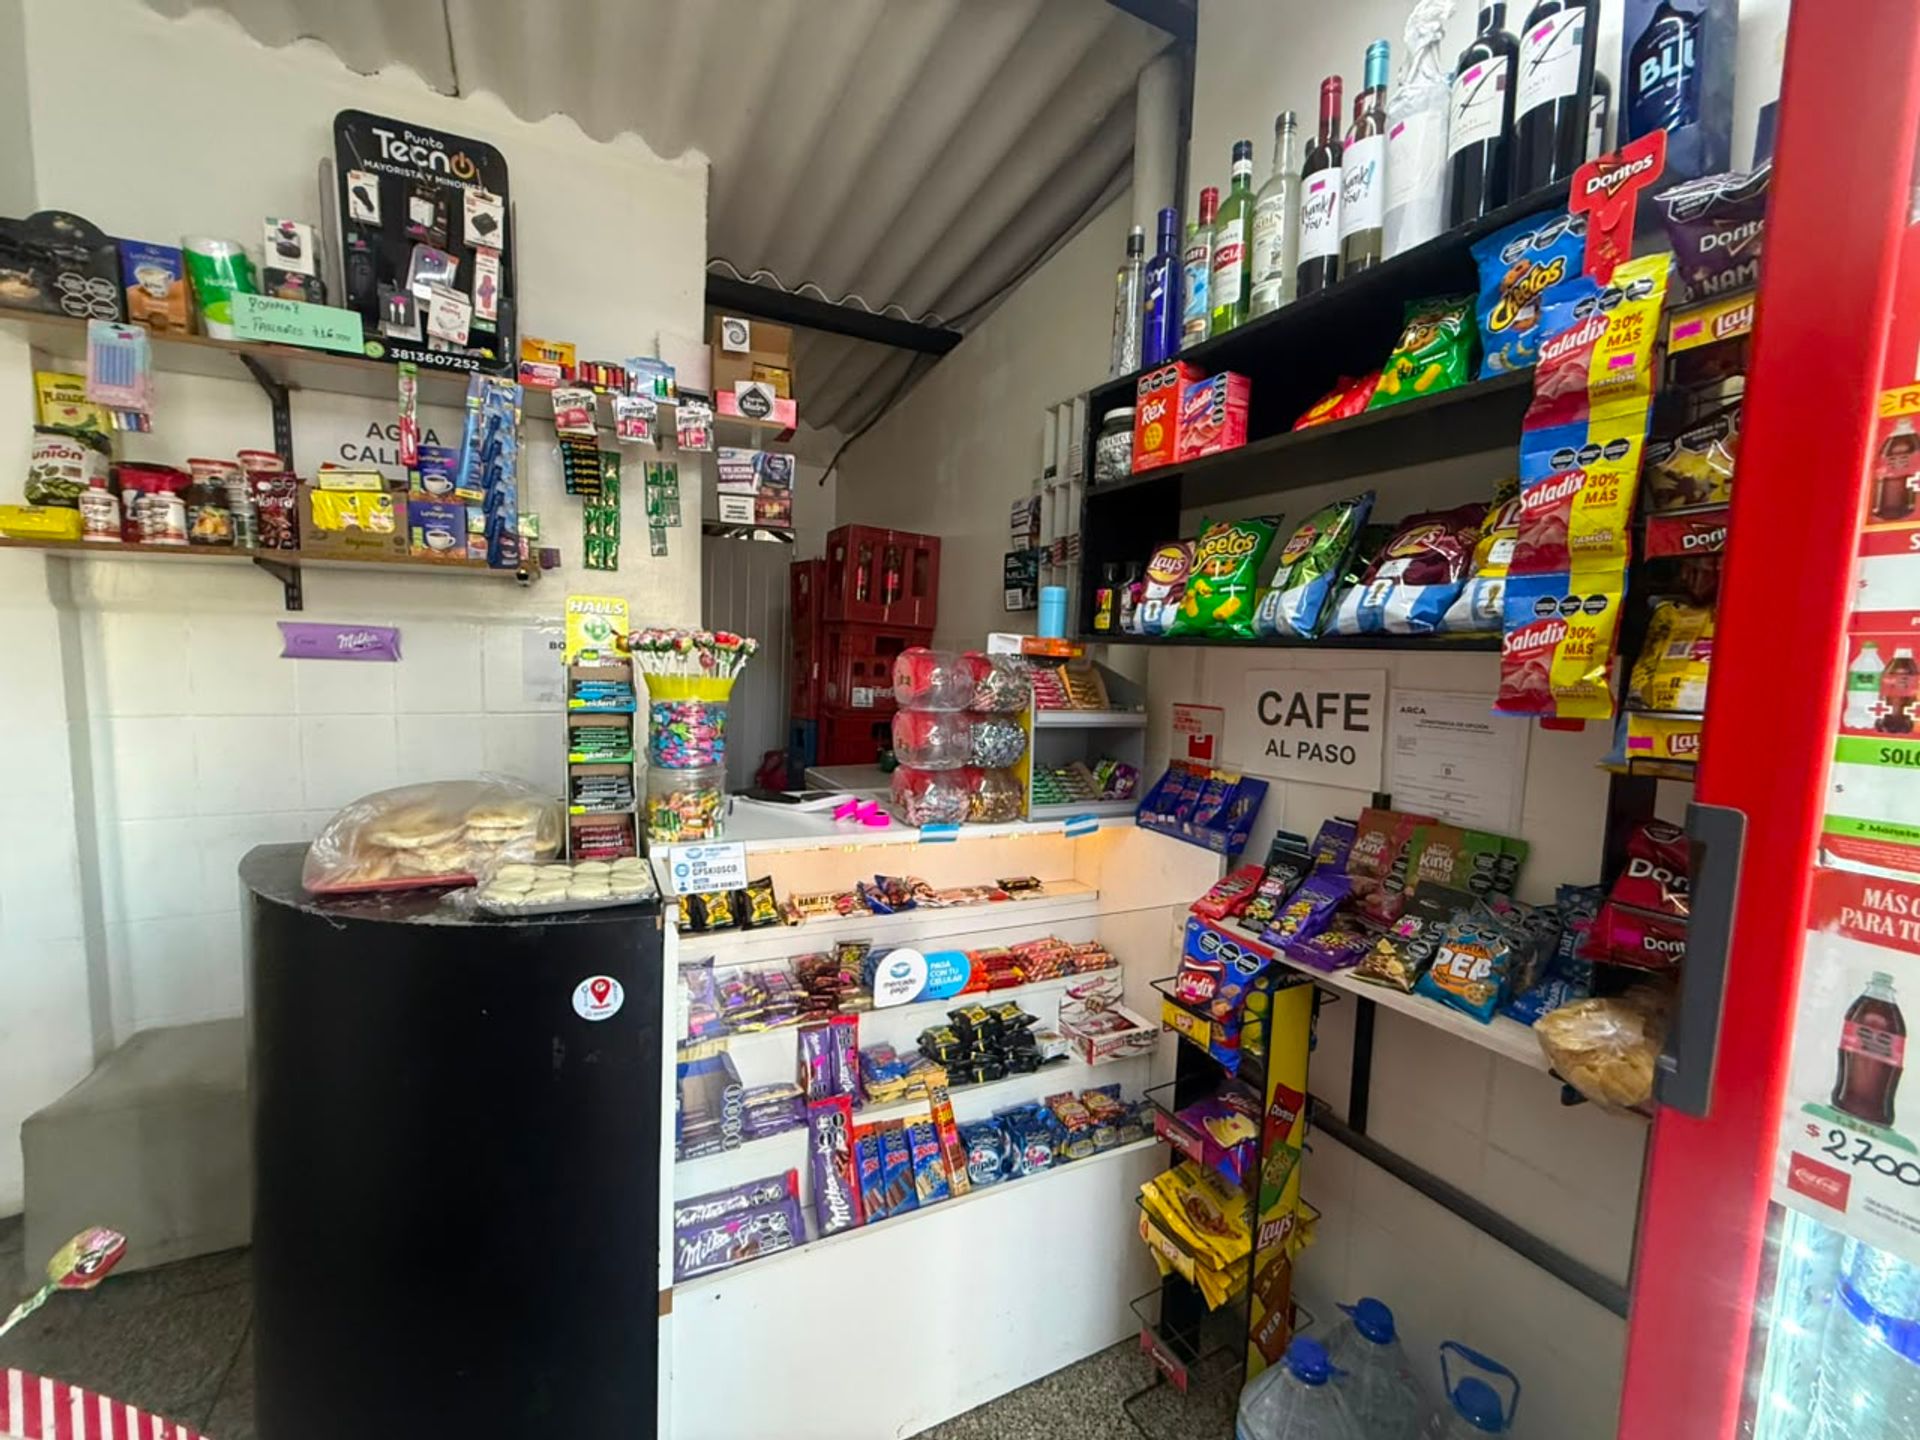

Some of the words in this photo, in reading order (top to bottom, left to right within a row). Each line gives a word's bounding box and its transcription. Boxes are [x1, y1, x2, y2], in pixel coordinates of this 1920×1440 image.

[404, 130, 444, 150] Punto
[363, 159, 423, 180] MAYORISTA
[425, 171, 433, 182] Y
[1586, 153, 1654, 194] Doritos
[1488, 256, 1567, 332] Cheetos
[1612, 311, 1645, 331] 30%
[1538, 317, 1608, 367] Saladix
[1606, 327, 1642, 348] MÁS
[390, 348, 480, 371] 3813607252
[366, 421, 441, 446] AGA
[1588, 472, 1620, 489] 30%
[1519, 472, 1586, 513] Saladix
[1584, 487, 1618, 504] MÁS
[569, 600, 626, 616] HALLS
[336, 631, 378, 650] Milka
[1502, 621, 1567, 655] Saladix
[1568, 626, 1597, 640] 30%
[1257, 690, 1372, 732] CAFE
[1400, 706, 1427, 715] ARCA
[1265, 738, 1291, 758] AL
[1297, 741, 1356, 765] PASO
[1862, 887, 1908, 915] MÁS
[1840, 906, 1895, 938] PARA
[1899, 920, 1920, 943] TU
[929, 969, 948, 977] CON
[930, 960, 951, 969] PAGA
[883, 978, 916, 988] mercado
[890, 986, 910, 995] pago
